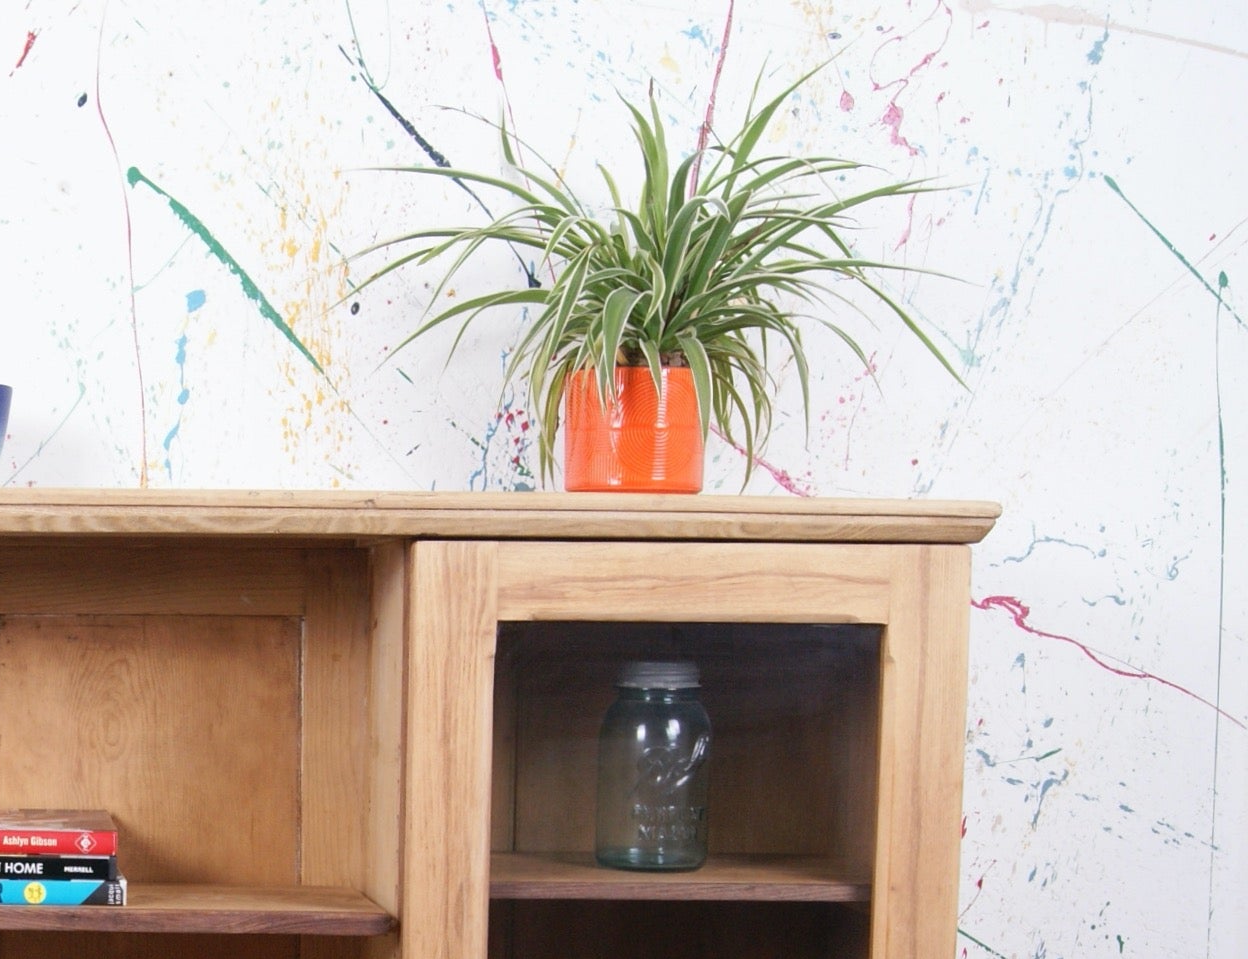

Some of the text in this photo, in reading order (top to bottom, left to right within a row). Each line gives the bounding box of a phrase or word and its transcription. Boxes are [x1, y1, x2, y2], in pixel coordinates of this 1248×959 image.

[2, 835, 29, 847] Ashlyn
[30, 836, 58, 847] Gibson
[4, 862, 44, 875] HOME
